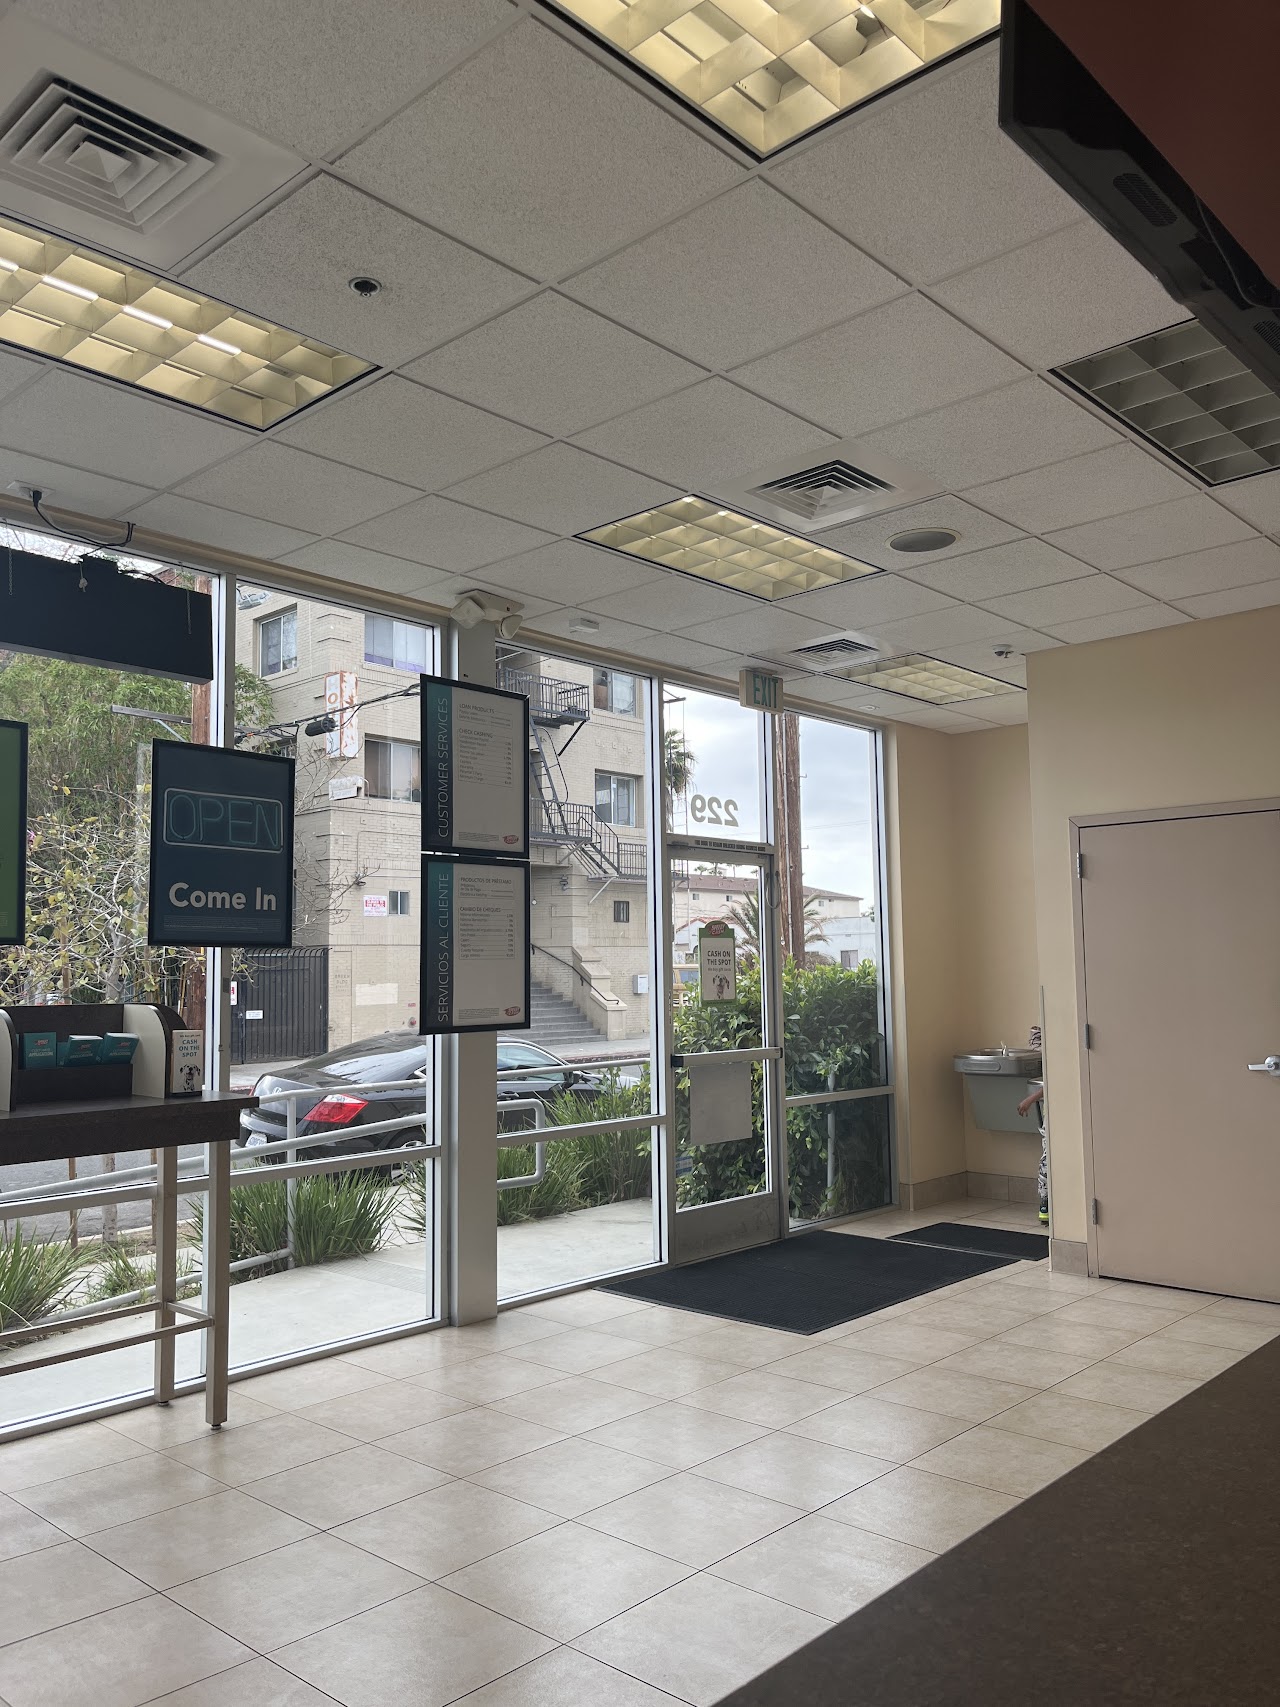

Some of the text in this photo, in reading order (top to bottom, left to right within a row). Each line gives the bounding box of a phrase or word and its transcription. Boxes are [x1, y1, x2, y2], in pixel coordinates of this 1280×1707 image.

[753, 673, 778, 709] EXIT
[472, 705, 495, 714] PRODUCTS
[459, 728, 493, 739] CHECK CASHING
[438, 698, 448, 838] CUSTOMER SERVICES
[169, 794, 279, 847] OPEN
[169, 882, 277, 911] Come In
[438, 873, 448, 1022] SERVICIOS AL CLIENTE
[707, 950, 731, 958] CASH ON
[718, 958, 731, 966] SPOT
